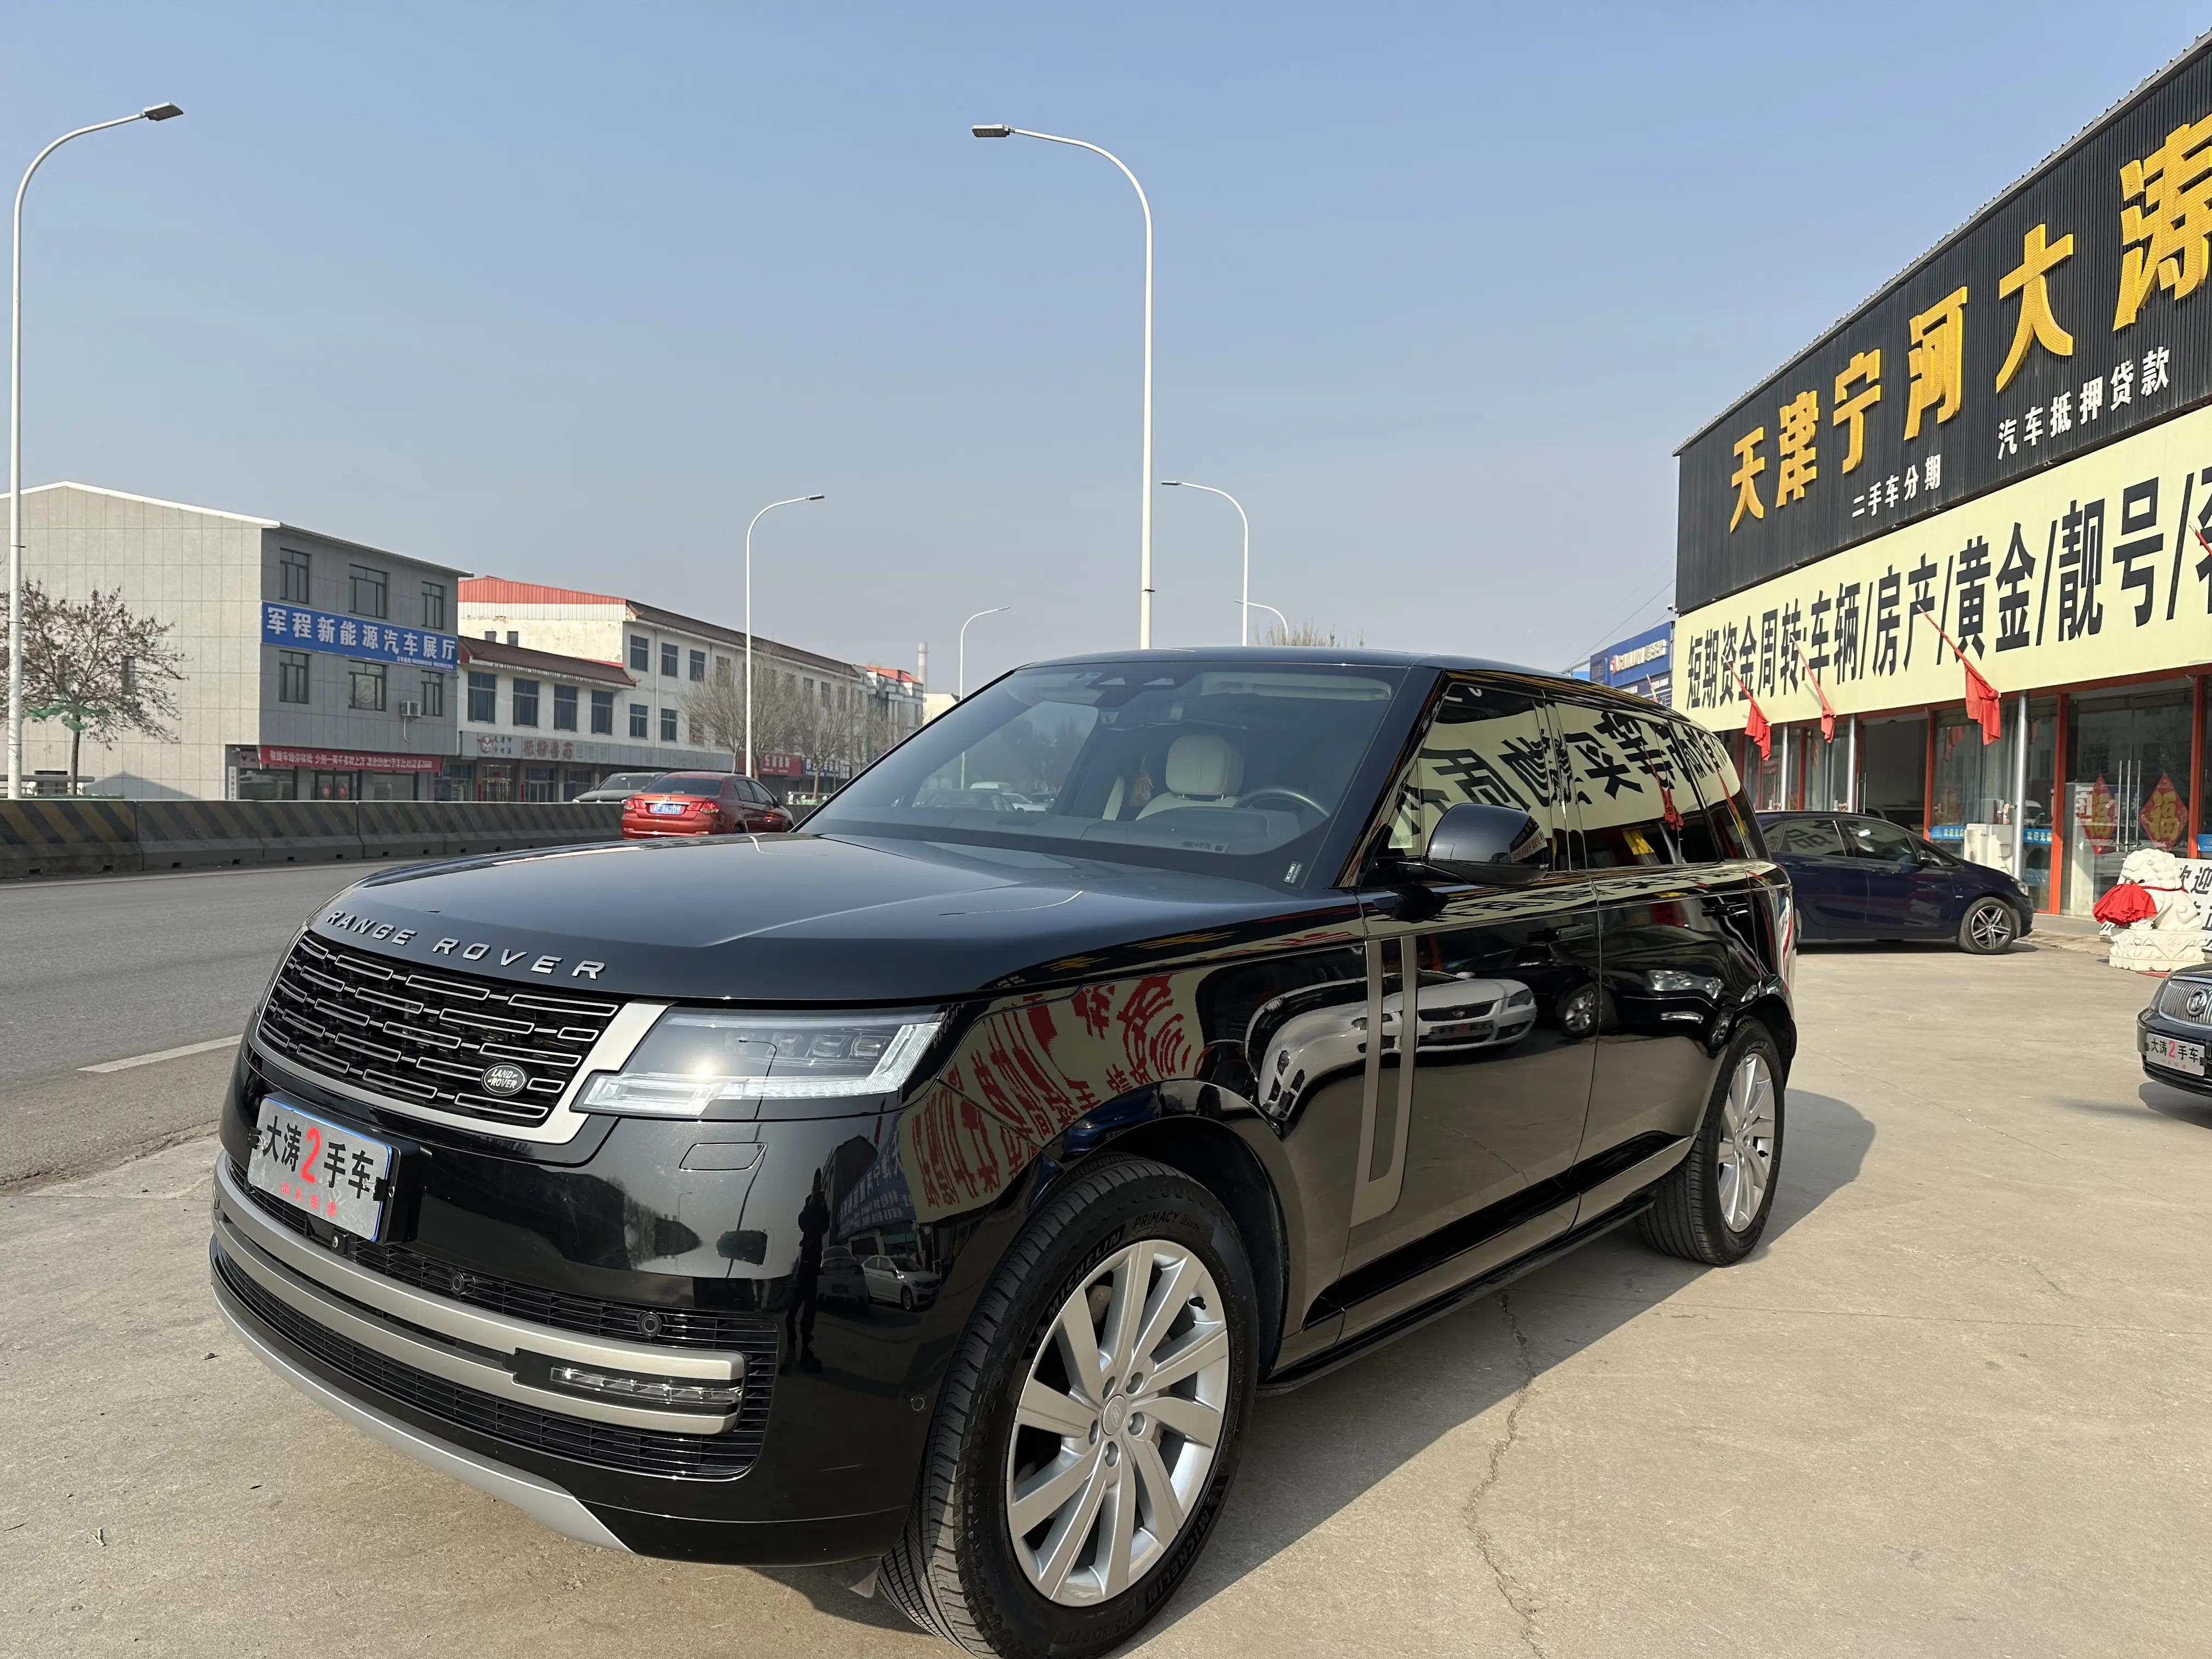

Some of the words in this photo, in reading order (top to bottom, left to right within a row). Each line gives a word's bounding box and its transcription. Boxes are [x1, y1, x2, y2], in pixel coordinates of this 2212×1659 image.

[1997, 346, 2170, 460] 汽车抵押贷款
[1852, 454, 1942, 518] 二手车分期
[267, 606, 456, 661] 军程新能源汽车展厅
[2027, 831, 2052, 842] 欢迎光临
[2149, 790, 2180, 841] 福
[326, 909, 418, 946] RANGE
[432, 936, 607, 980] ROVER
[491, 1068, 514, 1079] LAND
[2151, 1037, 2199, 1063] 大涛2手车
[490, 1077, 517, 1089] ROVER
[263, 1115, 374, 1199] 大涛2手车
[1133, 1210, 1181, 1230] PRIMACY
[1180, 1217, 1200, 1232] SEASON
[1048, 1231, 1121, 1322] MICHELIN
[1148, 1509, 1211, 1604] MICHELIN
